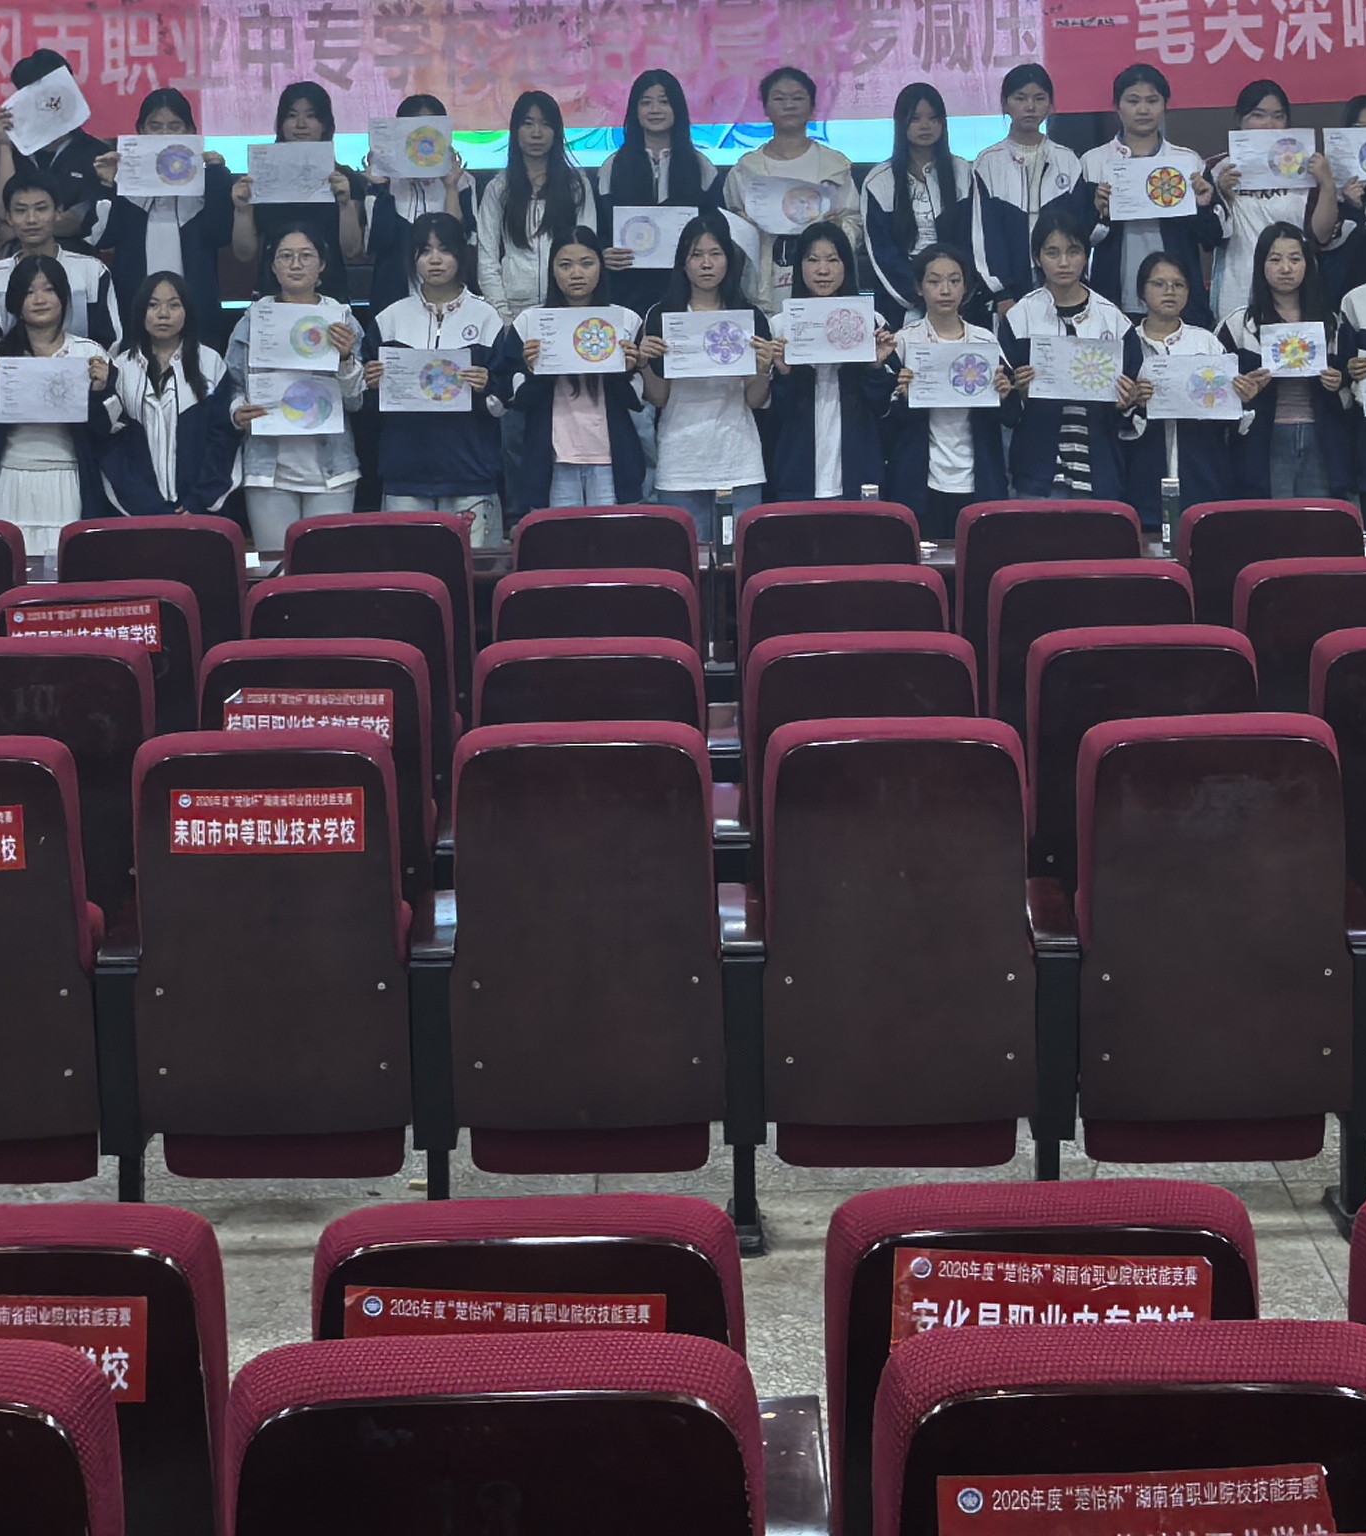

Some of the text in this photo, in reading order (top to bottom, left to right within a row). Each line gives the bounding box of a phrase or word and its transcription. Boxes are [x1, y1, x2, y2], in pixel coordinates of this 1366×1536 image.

[174, 817, 355, 846] 耒阳市中等职业技术学校
